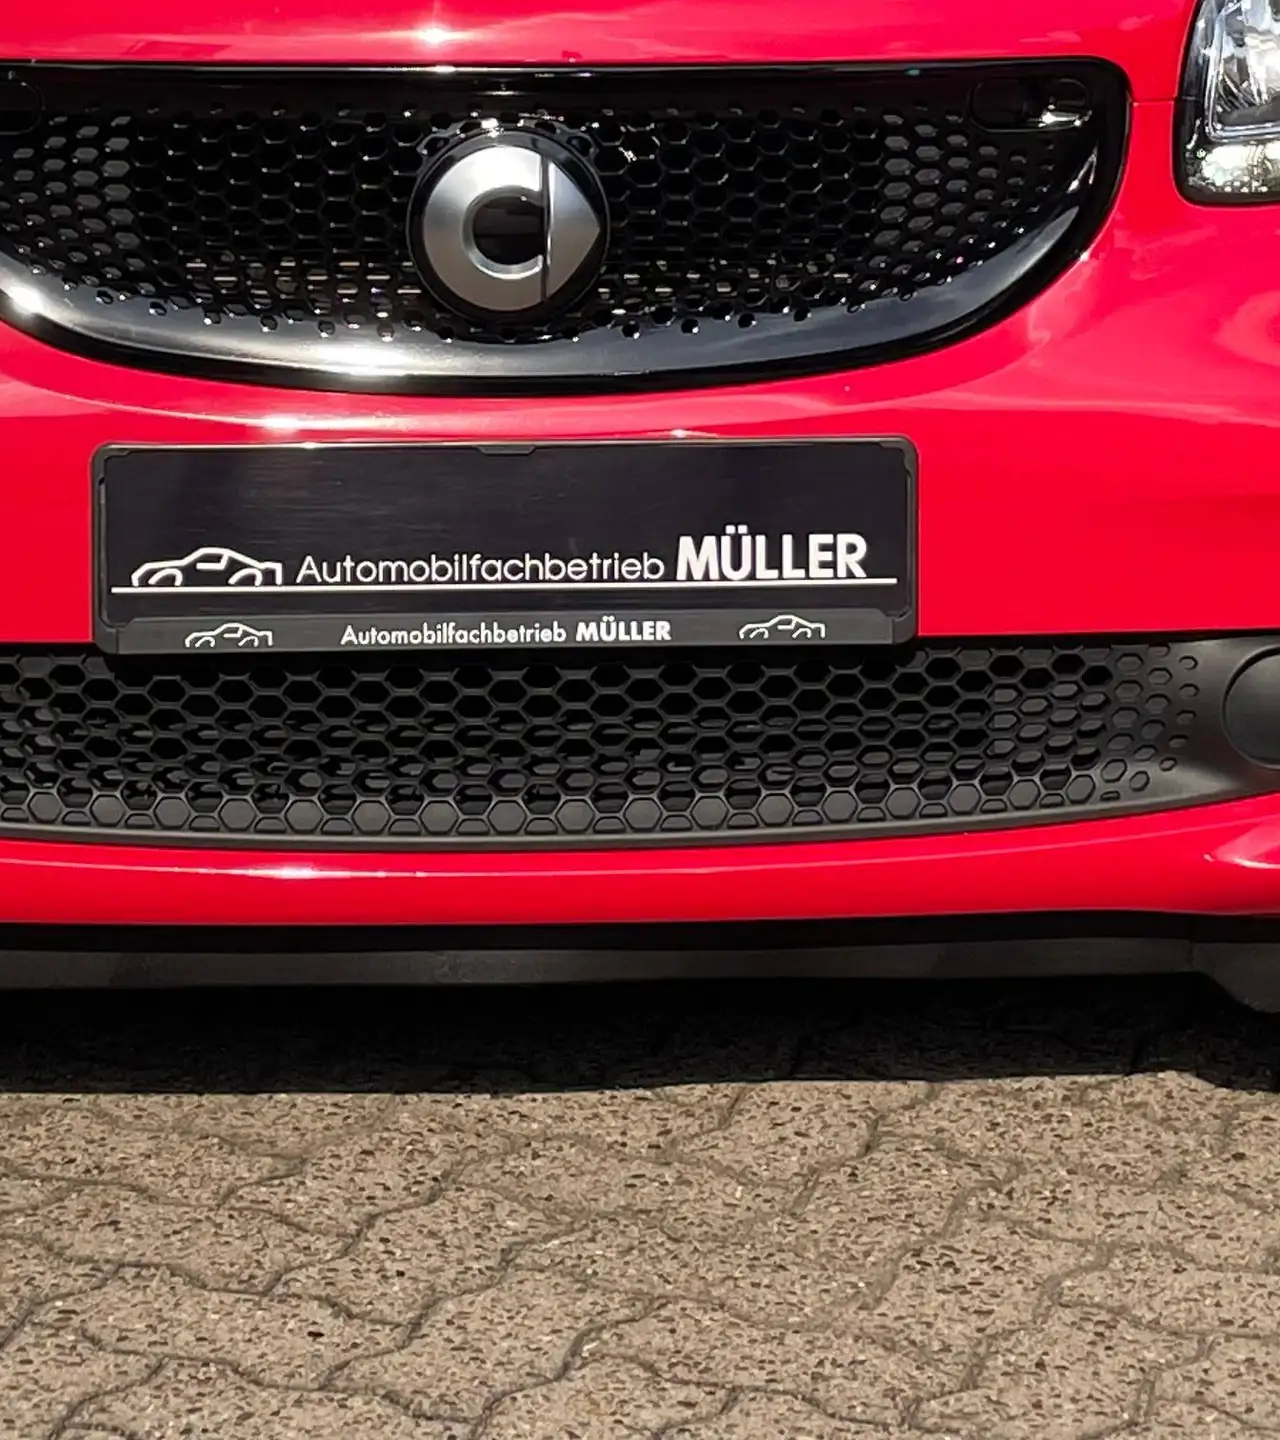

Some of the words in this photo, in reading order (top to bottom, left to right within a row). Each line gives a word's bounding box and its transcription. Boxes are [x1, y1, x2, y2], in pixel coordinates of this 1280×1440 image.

[296, 553, 665, 584] Automobilfachbetrieb
[676, 524, 867, 581] MÜLLER
[340, 622, 567, 647] Automobilfachbetrieb
[575, 615, 671, 642] MÜLLER
